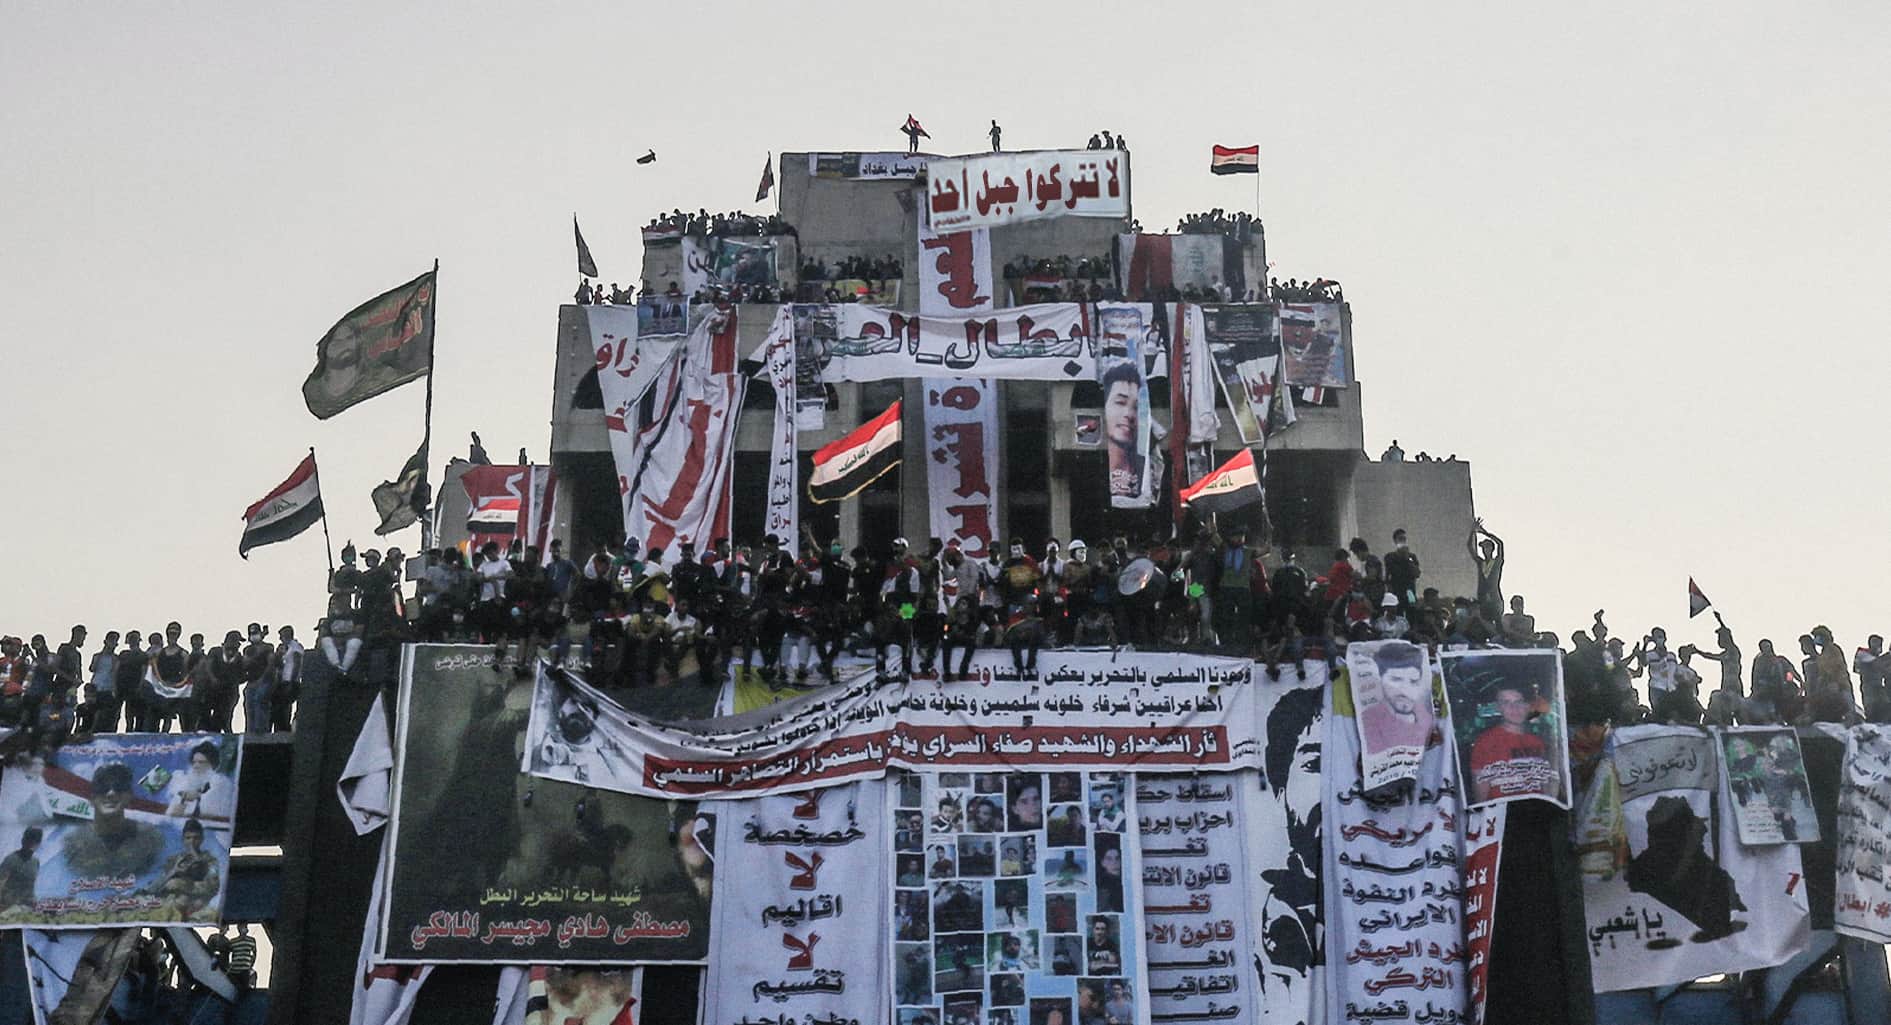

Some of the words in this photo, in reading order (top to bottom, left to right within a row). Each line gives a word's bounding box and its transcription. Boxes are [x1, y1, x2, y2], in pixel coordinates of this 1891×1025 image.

[1026, 163, 1100, 211] تتركوا
[1106, 157, 1120, 197] لا
[976, 169, 1019, 217] جبل
[1044, 665, 1085, 686] يعكس
[1088, 665, 1146, 687] بالتحرير
[1151, 667, 1205, 691] السلمي
[981, 695, 1040, 716] سلميين
[1044, 694, 1084, 716] خلونه
[1092, 695, 1131, 716] شرفاء
[1136, 695, 1192, 716] عراقيين
[922, 733, 986, 761] السراي
[992, 733, 1032, 754] صفاء
[1038, 732, 1116, 757] والشهيد
[1120, 733, 1190, 755] الشهداء
[1193, 729, 1216, 757] ثأر
[1175, 810, 1234, 835] احزاب
[785, 850, 825, 891] لا
[1185, 863, 1232, 889] قانون
[479, 887, 518, 906] البطل
[520, 886, 570, 907] التحرير
[573, 885, 607, 903] ساحة
[610, 886, 641, 905] شهيد
[1343, 877, 1416, 905] النفوذ
[762, 894, 843, 929] اقاليم
[1359, 902, 1457, 934] الايراني
[411, 909, 480, 949] المالكي
[557, 911, 610, 949] هادي
[613, 910, 691, 945] مصطفى
[1180, 919, 1235, 948] قانون
[782, 931, 822, 972] لا
[1346, 938, 1423, 966] الجيش
[752, 968, 845, 1003] تقسيم
[1148, 975, 1239, 1000] اتفاقي
[1363, 966, 1454, 997] التركي
